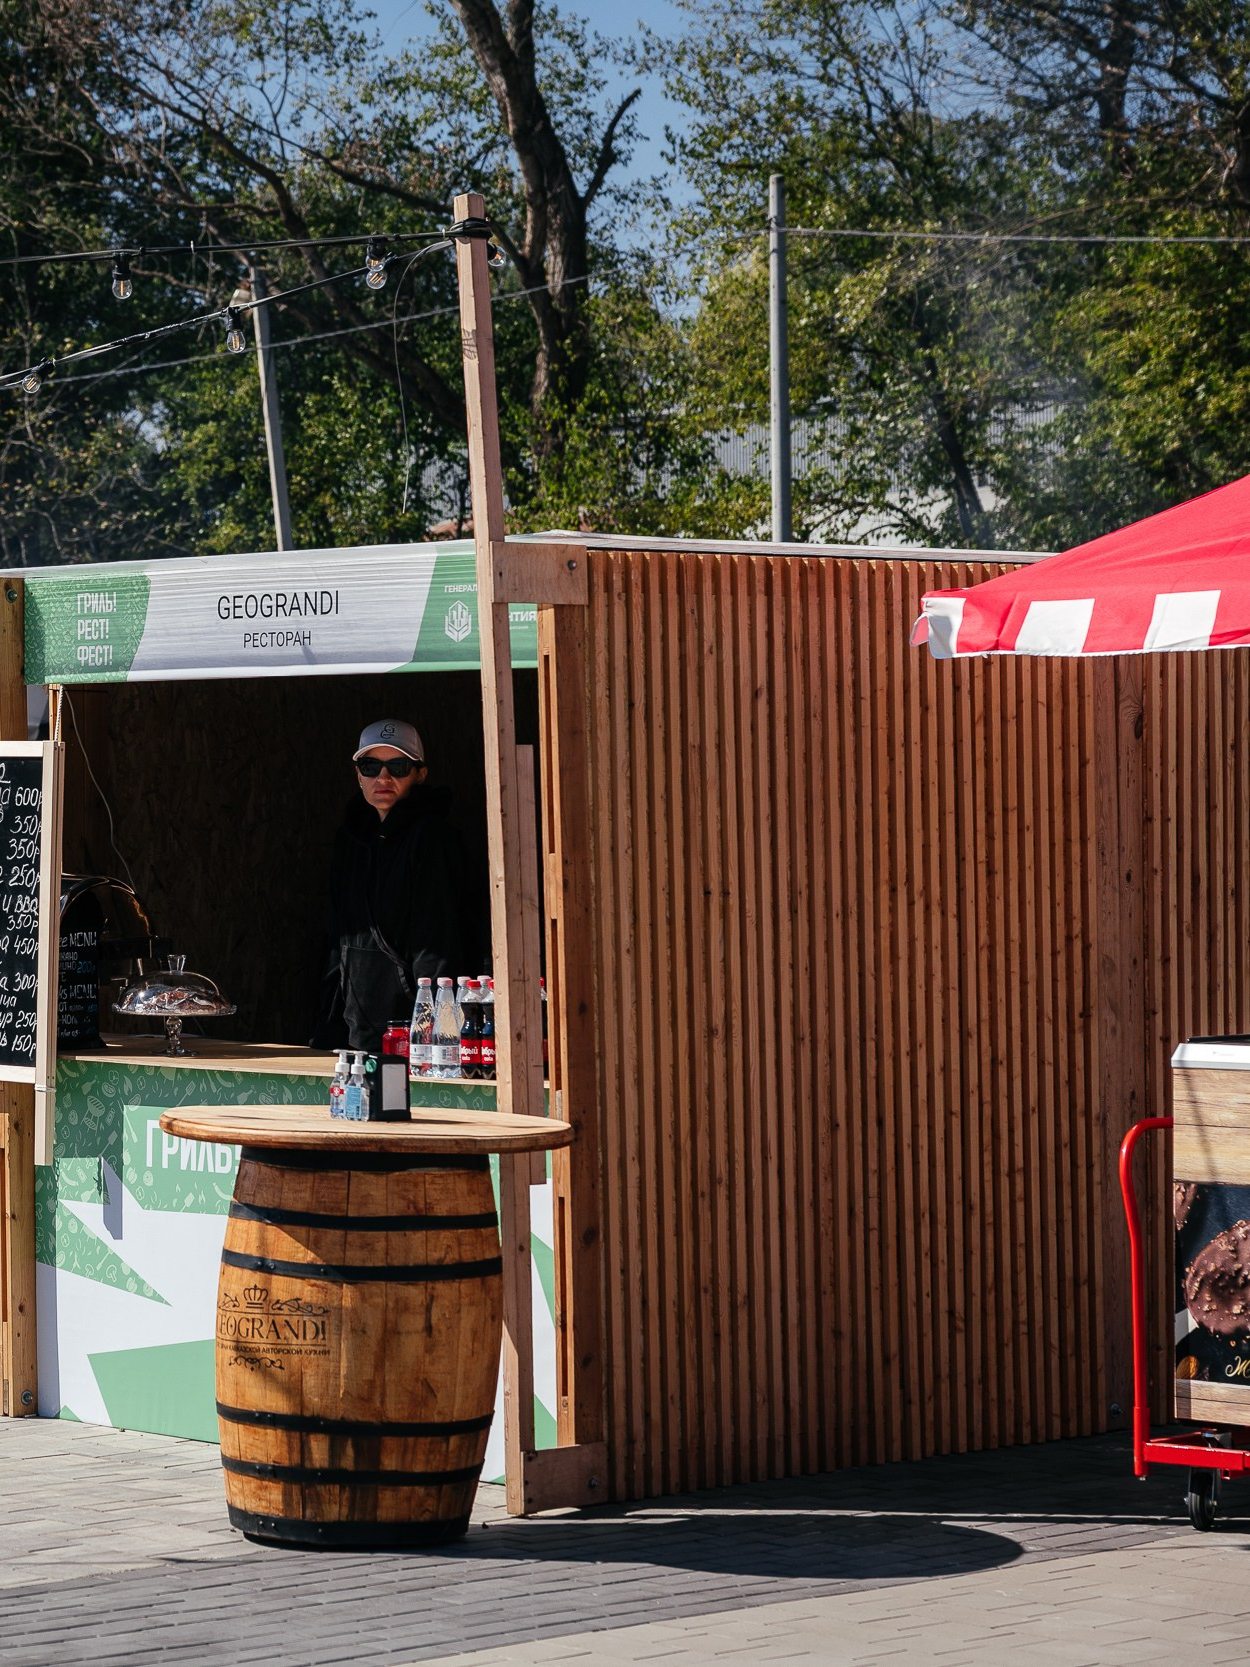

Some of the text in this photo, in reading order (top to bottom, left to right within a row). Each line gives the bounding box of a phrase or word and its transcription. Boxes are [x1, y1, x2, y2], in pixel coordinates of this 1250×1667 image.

[444, 584, 478, 593] ГЕНЕРАЛ
[77, 591, 117, 614] ГРИЛЬ!
[217, 590, 340, 620] GEOGRANDI
[77, 618, 110, 641] РЕСТ!
[243, 630, 311, 649] РЕСТОРАН
[77, 644, 113, 667] ФЕСТ!
